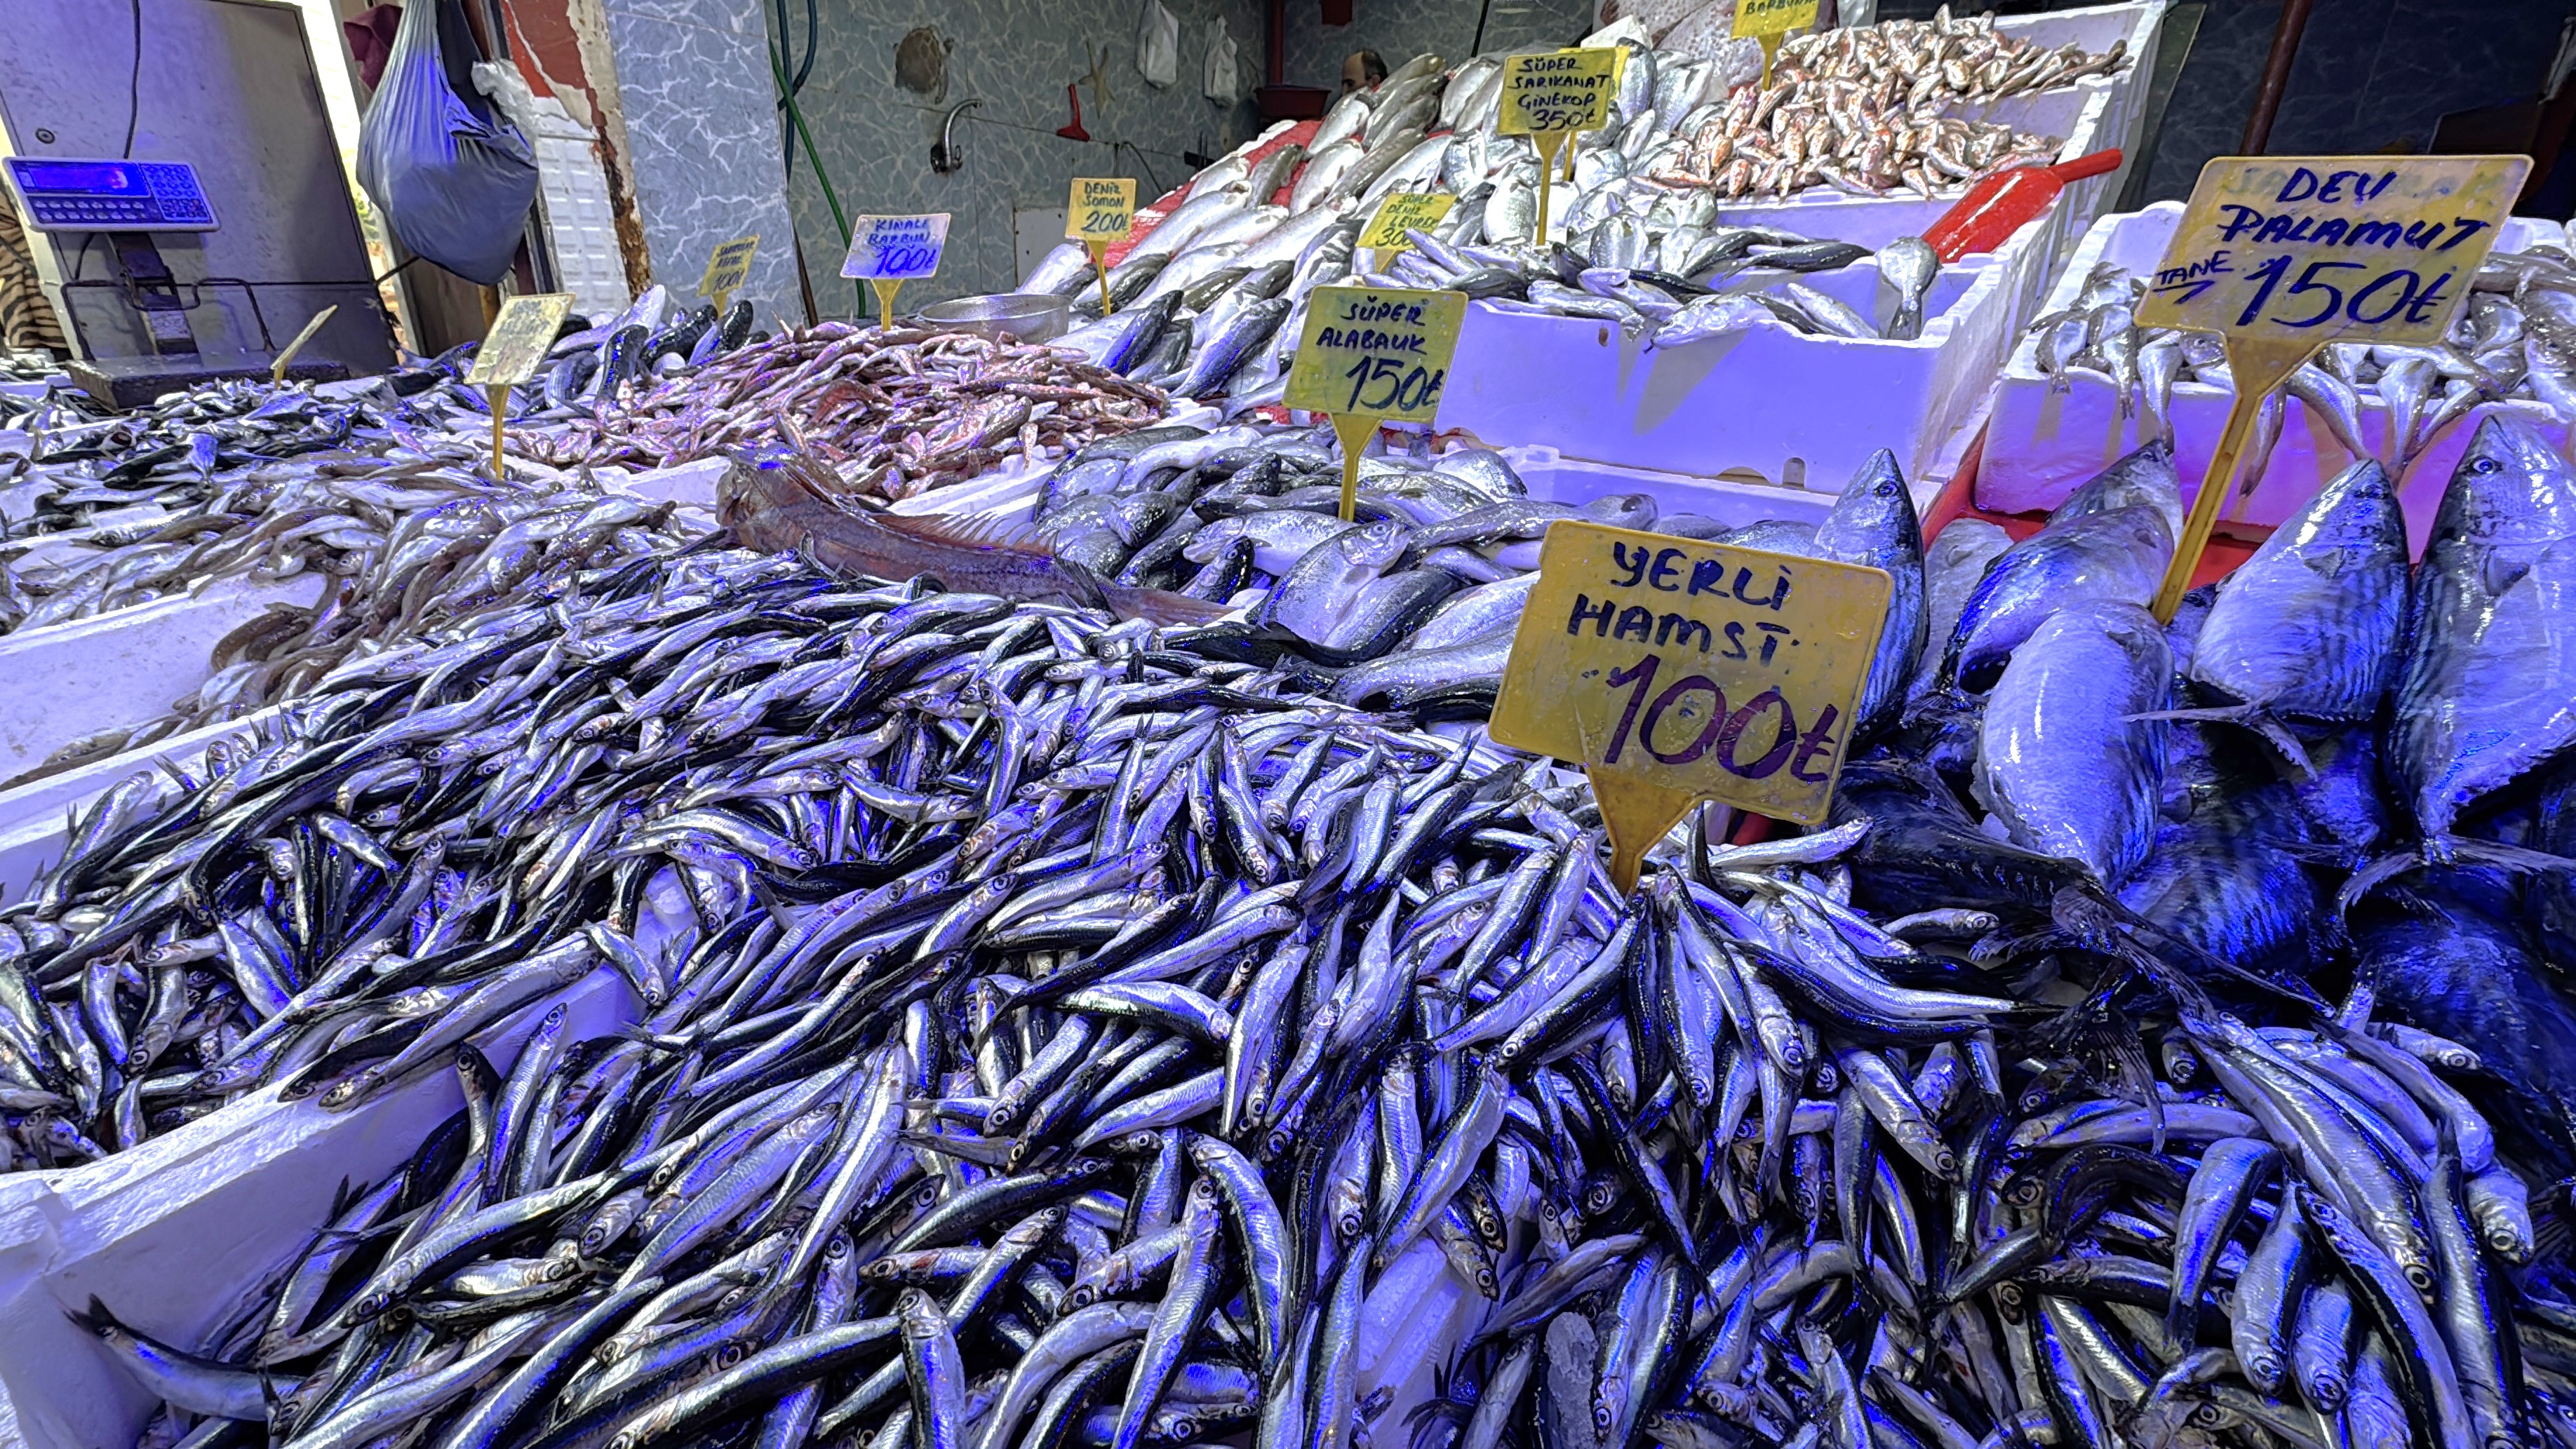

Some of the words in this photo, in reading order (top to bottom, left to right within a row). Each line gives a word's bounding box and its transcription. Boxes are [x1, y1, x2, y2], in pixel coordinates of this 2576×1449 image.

[1517, 57, 1583, 72] SÜPER
[1508, 74, 1610, 89] SARIKANAT
[1082, 194, 1125, 207] SOMON
[2217, 204, 2492, 251] PALAMUT
[2156, 250, 2234, 285] TANE
[1341, 295, 1425, 327] SÜPER
[1611, 541, 1792, 611] YERLİ
